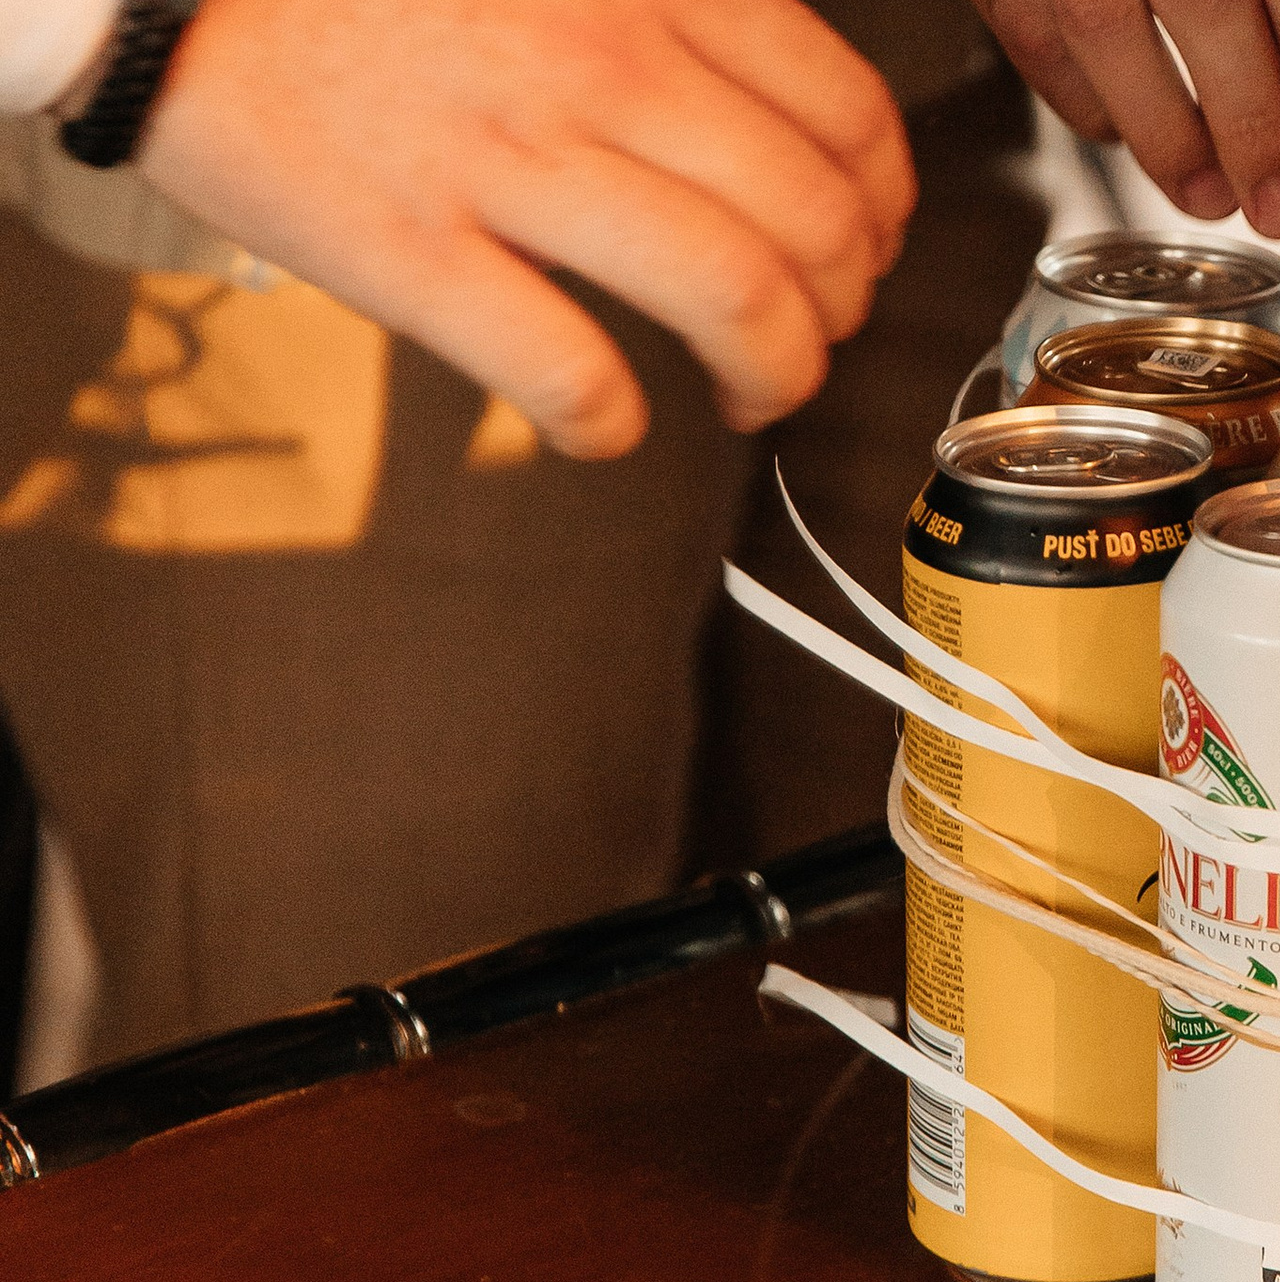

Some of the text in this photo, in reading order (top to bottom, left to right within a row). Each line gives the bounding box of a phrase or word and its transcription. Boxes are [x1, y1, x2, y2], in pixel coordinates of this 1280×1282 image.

[926, 511, 963, 545] BEER
[1043, 523, 1189, 560] PUSŤ DO SEBE
[1234, 777, 1260, 808] 500
[1180, 912, 1186, 928] E
[953, 1054, 964, 1075] 64
[953, 1128, 964, 1192] 594012
[953, 1204, 964, 1215] 8
